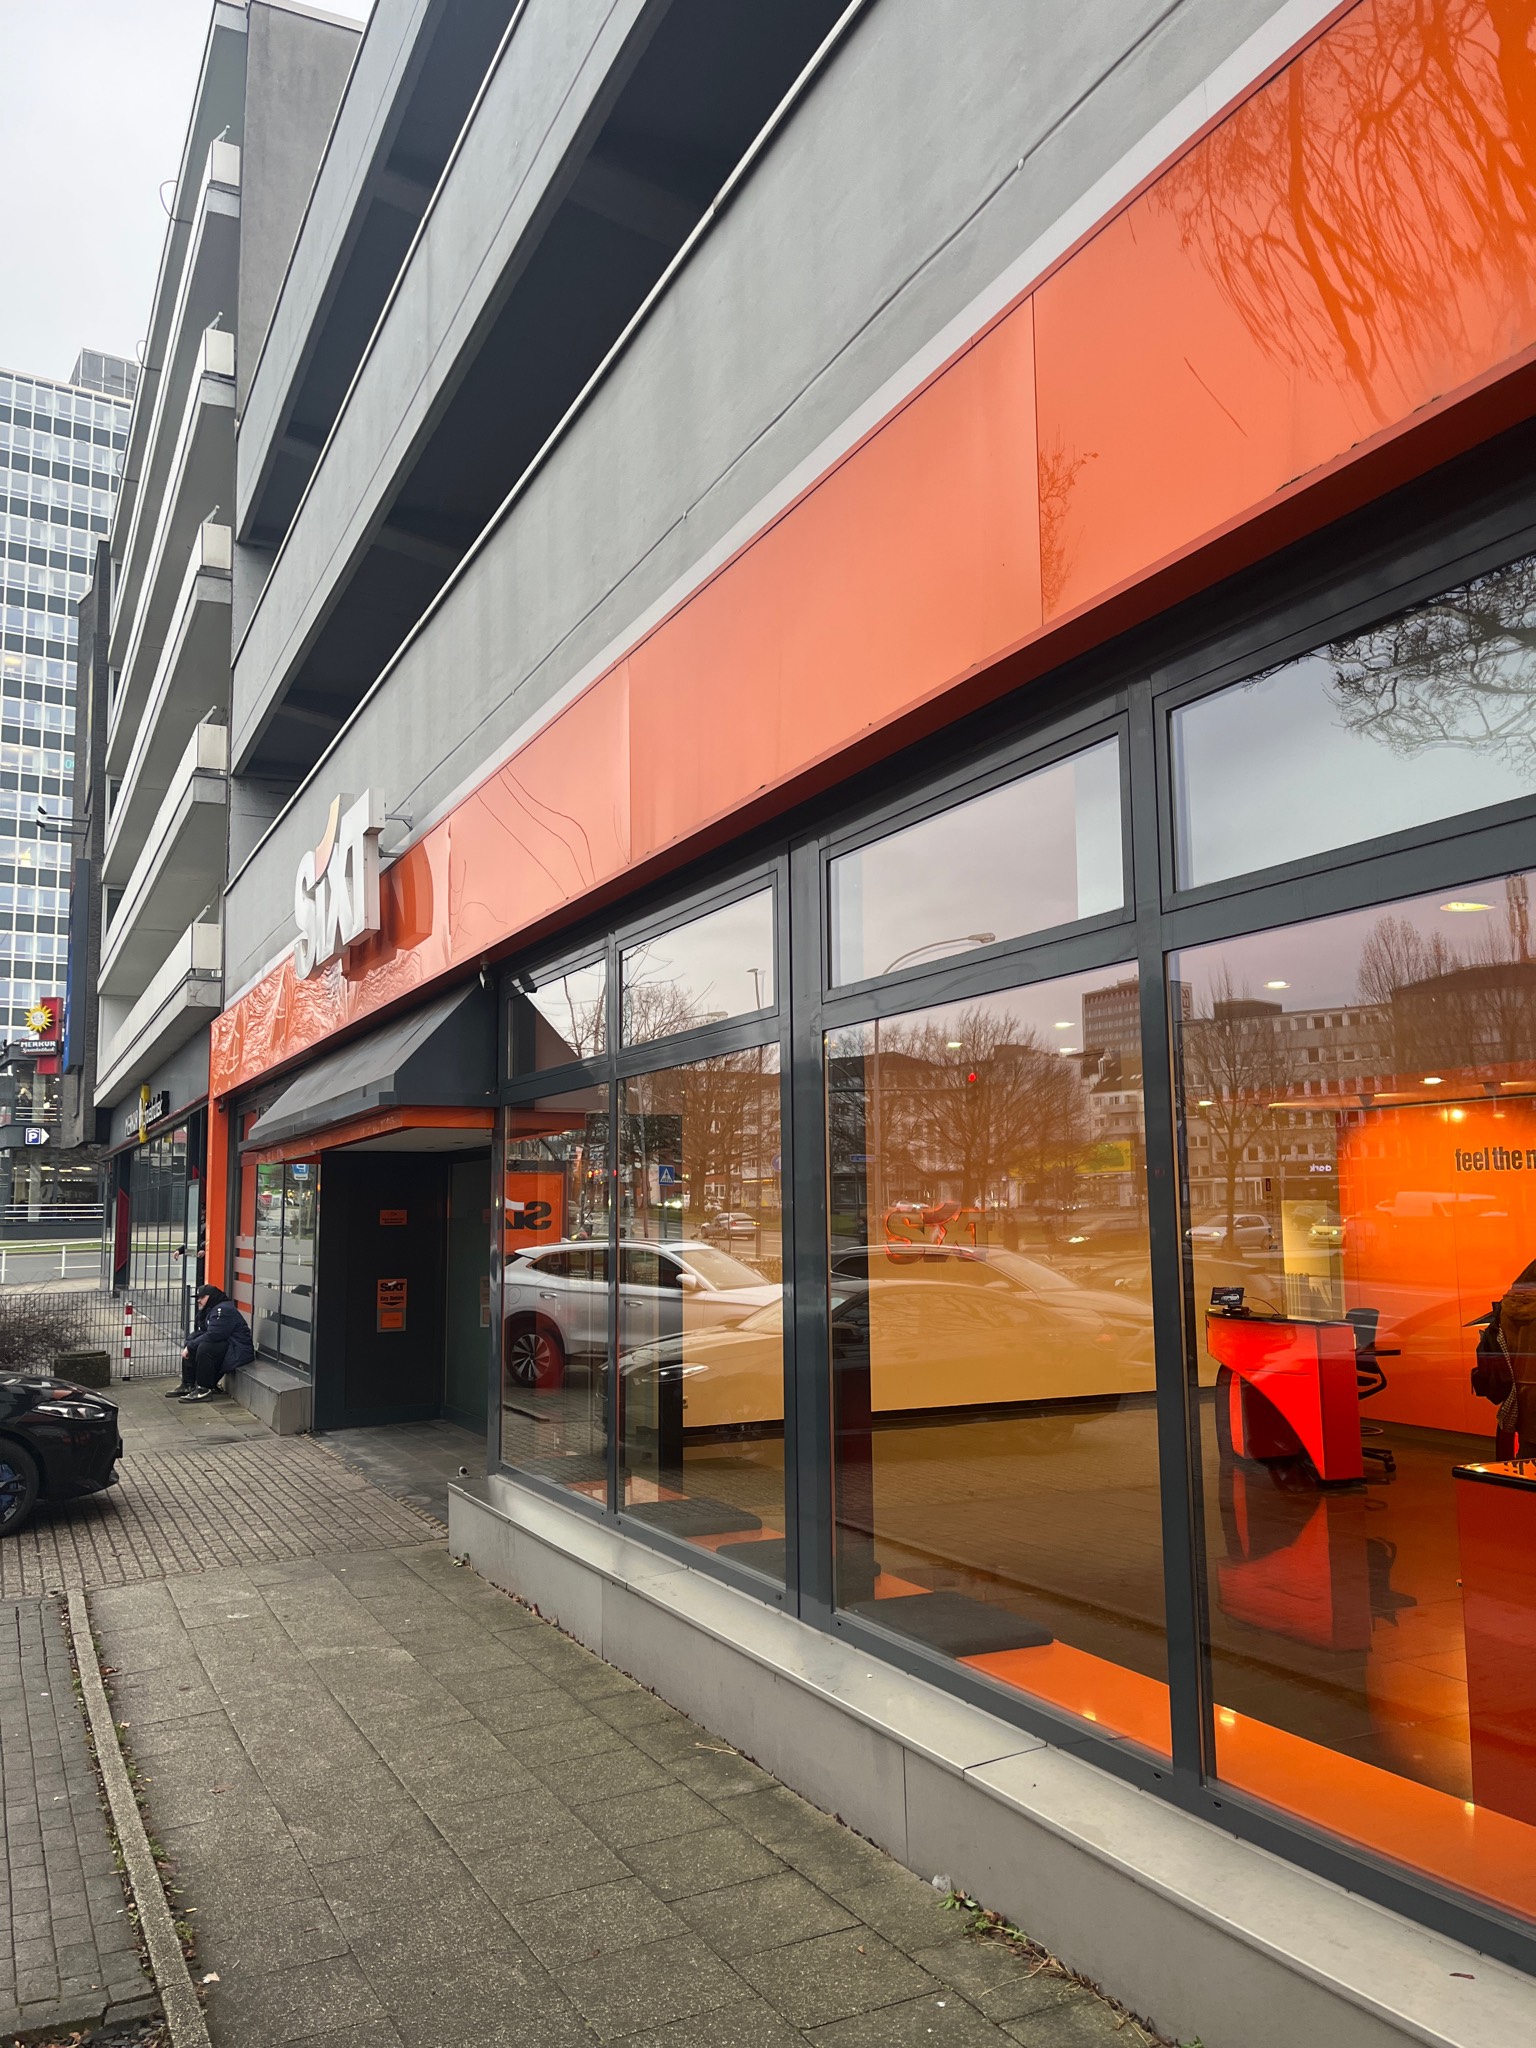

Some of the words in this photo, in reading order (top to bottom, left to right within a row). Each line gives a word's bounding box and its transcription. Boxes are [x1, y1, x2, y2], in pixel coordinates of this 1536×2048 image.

[294, 788, 384, 980] SIXT
[1455, 1147, 1490, 1171] feel
[1492, 1146, 1523, 1170] the
[380, 1281, 405, 1292] SIXT
